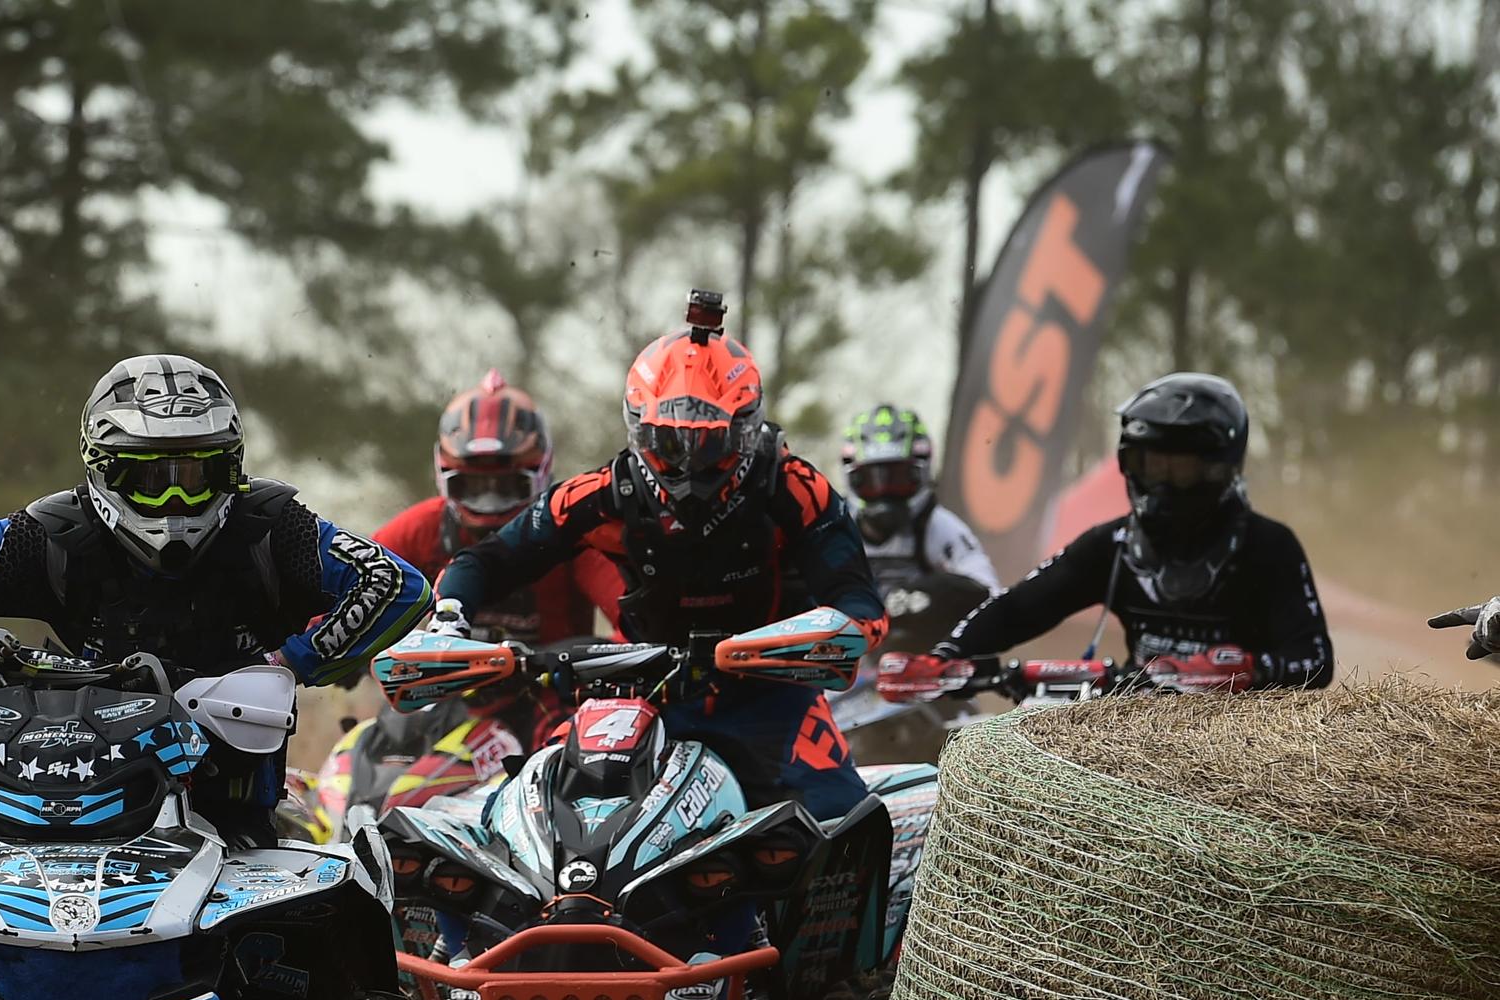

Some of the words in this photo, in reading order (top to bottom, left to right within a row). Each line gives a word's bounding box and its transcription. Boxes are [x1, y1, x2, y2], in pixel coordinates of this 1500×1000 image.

[961, 192, 1107, 534] CST
[584, 709, 640, 742] 4
[21, 734, 95, 743] MOMENTUM
[584, 752, 631, 765] can-am
